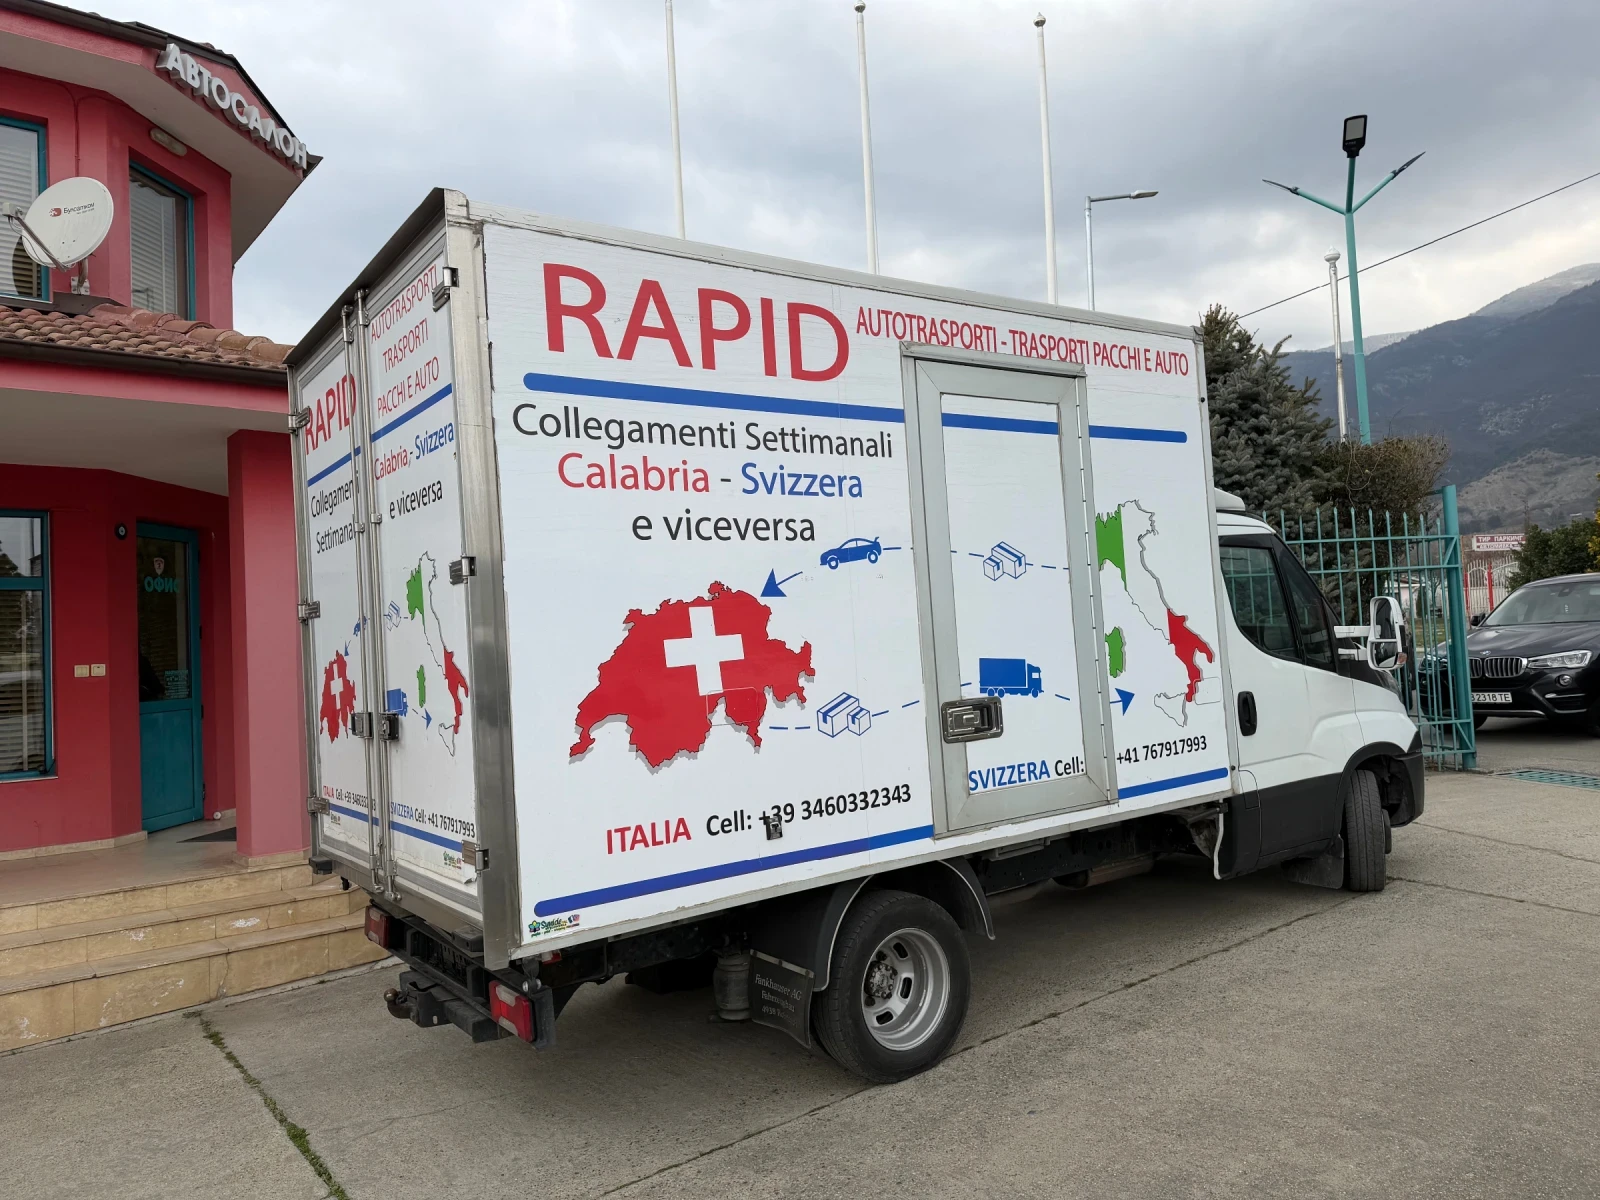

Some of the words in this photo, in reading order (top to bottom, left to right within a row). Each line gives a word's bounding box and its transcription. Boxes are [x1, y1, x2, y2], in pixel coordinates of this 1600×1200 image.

[156, 43, 308, 170] АВТОСАЛОН
[371, 264, 438, 344] AUTOTRASPORTI
[543, 263, 849, 381] RAPID
[383, 318, 429, 373] TRASPORTI
[856, 306, 998, 353] AUTOTRASPORTI
[1009, 329, 1090, 364] TRASPORTI
[1094, 342, 1141, 370] PACCHI
[1144, 348, 1152, 372] E
[1155, 350, 1189, 376] AUTO
[305, 373, 357, 455] RAPID
[378, 380, 406, 419] PACCHI
[407, 375, 414, 399] E
[415, 356, 440, 395] AUTO
[374, 445, 408, 480] Calabria
[415, 422, 455, 460] Svizzera
[512, 403, 736, 449] Collegamenti
[746, 423, 893, 458] Settimanali
[311, 470, 360, 518] Collegameni
[389, 501, 396, 519] e
[397, 480, 443, 516] viceversa
[558, 452, 710, 493] Calabria
[741, 463, 863, 498] Svizzera
[316, 514, 356, 554] Settimanal
[632, 515, 653, 541] e
[663, 508, 815, 541] viceversa
[969, 760, 1050, 791] SVIZZERA
[1055, 756, 1085, 777] Cell:
[1117, 747, 1140, 764] +41
[1143, 735, 1208, 761] 767917993
[391, 802, 414, 821] SVIZZERA
[415, 808, 427, 824] Cell:
[428, 812, 439, 828] +41
[440, 814, 476, 838] 767917993
[606, 817, 692, 854] ITALIA
[706, 809, 752, 836] Cell:
[759, 803, 795, 825] +39
[801, 784, 911, 820] 3460332343
[755, 973, 790, 996] Fankhauser
[791, 989, 803, 1001] AG
